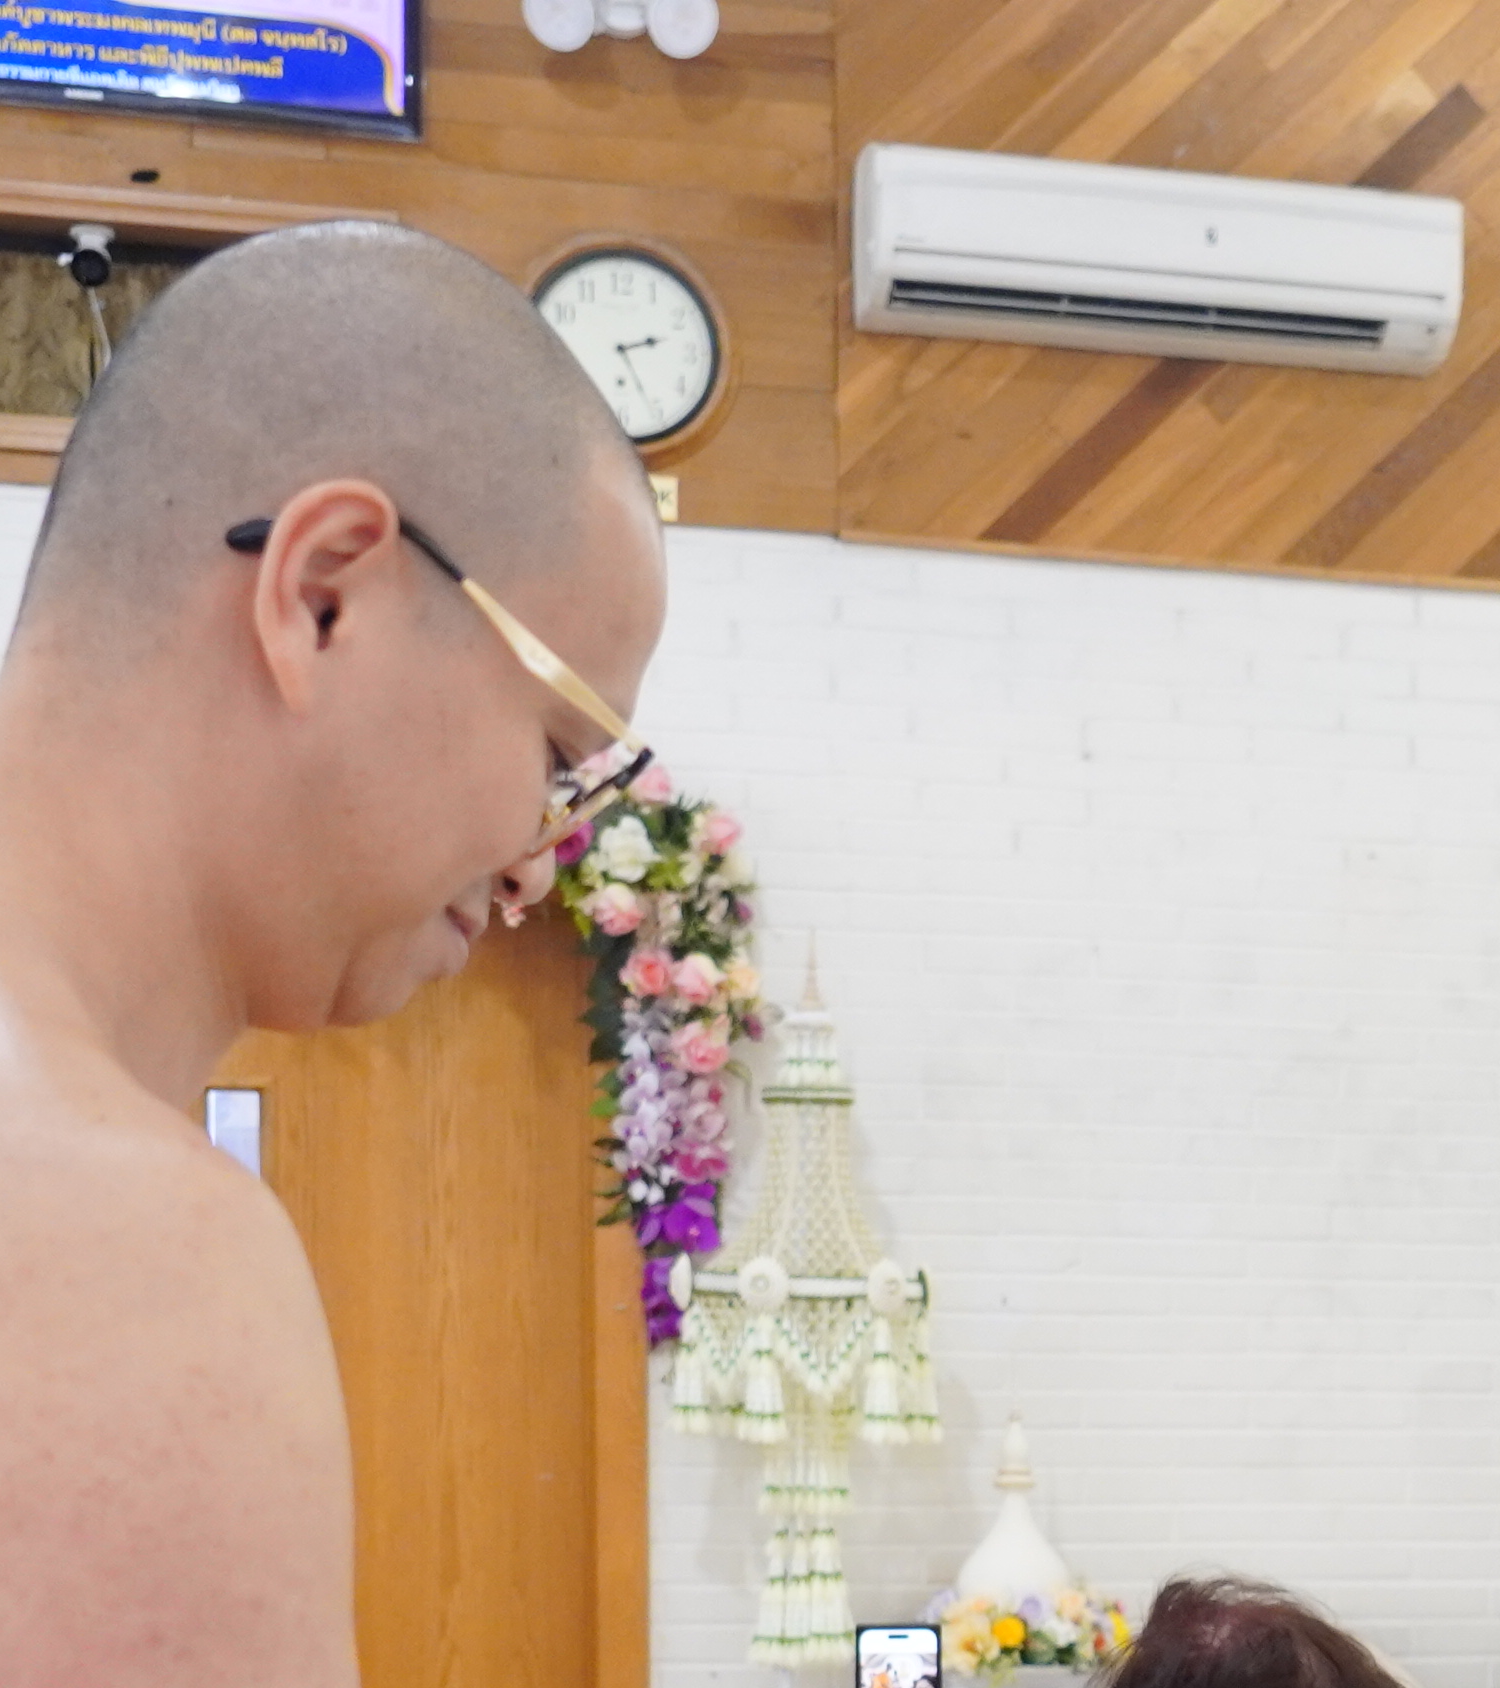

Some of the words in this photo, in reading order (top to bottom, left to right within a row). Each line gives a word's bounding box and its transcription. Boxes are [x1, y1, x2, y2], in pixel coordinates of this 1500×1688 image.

[578, 279, 596, 303] 11
[610, 272, 635, 297] 12
[554, 302, 576, 325] 10
